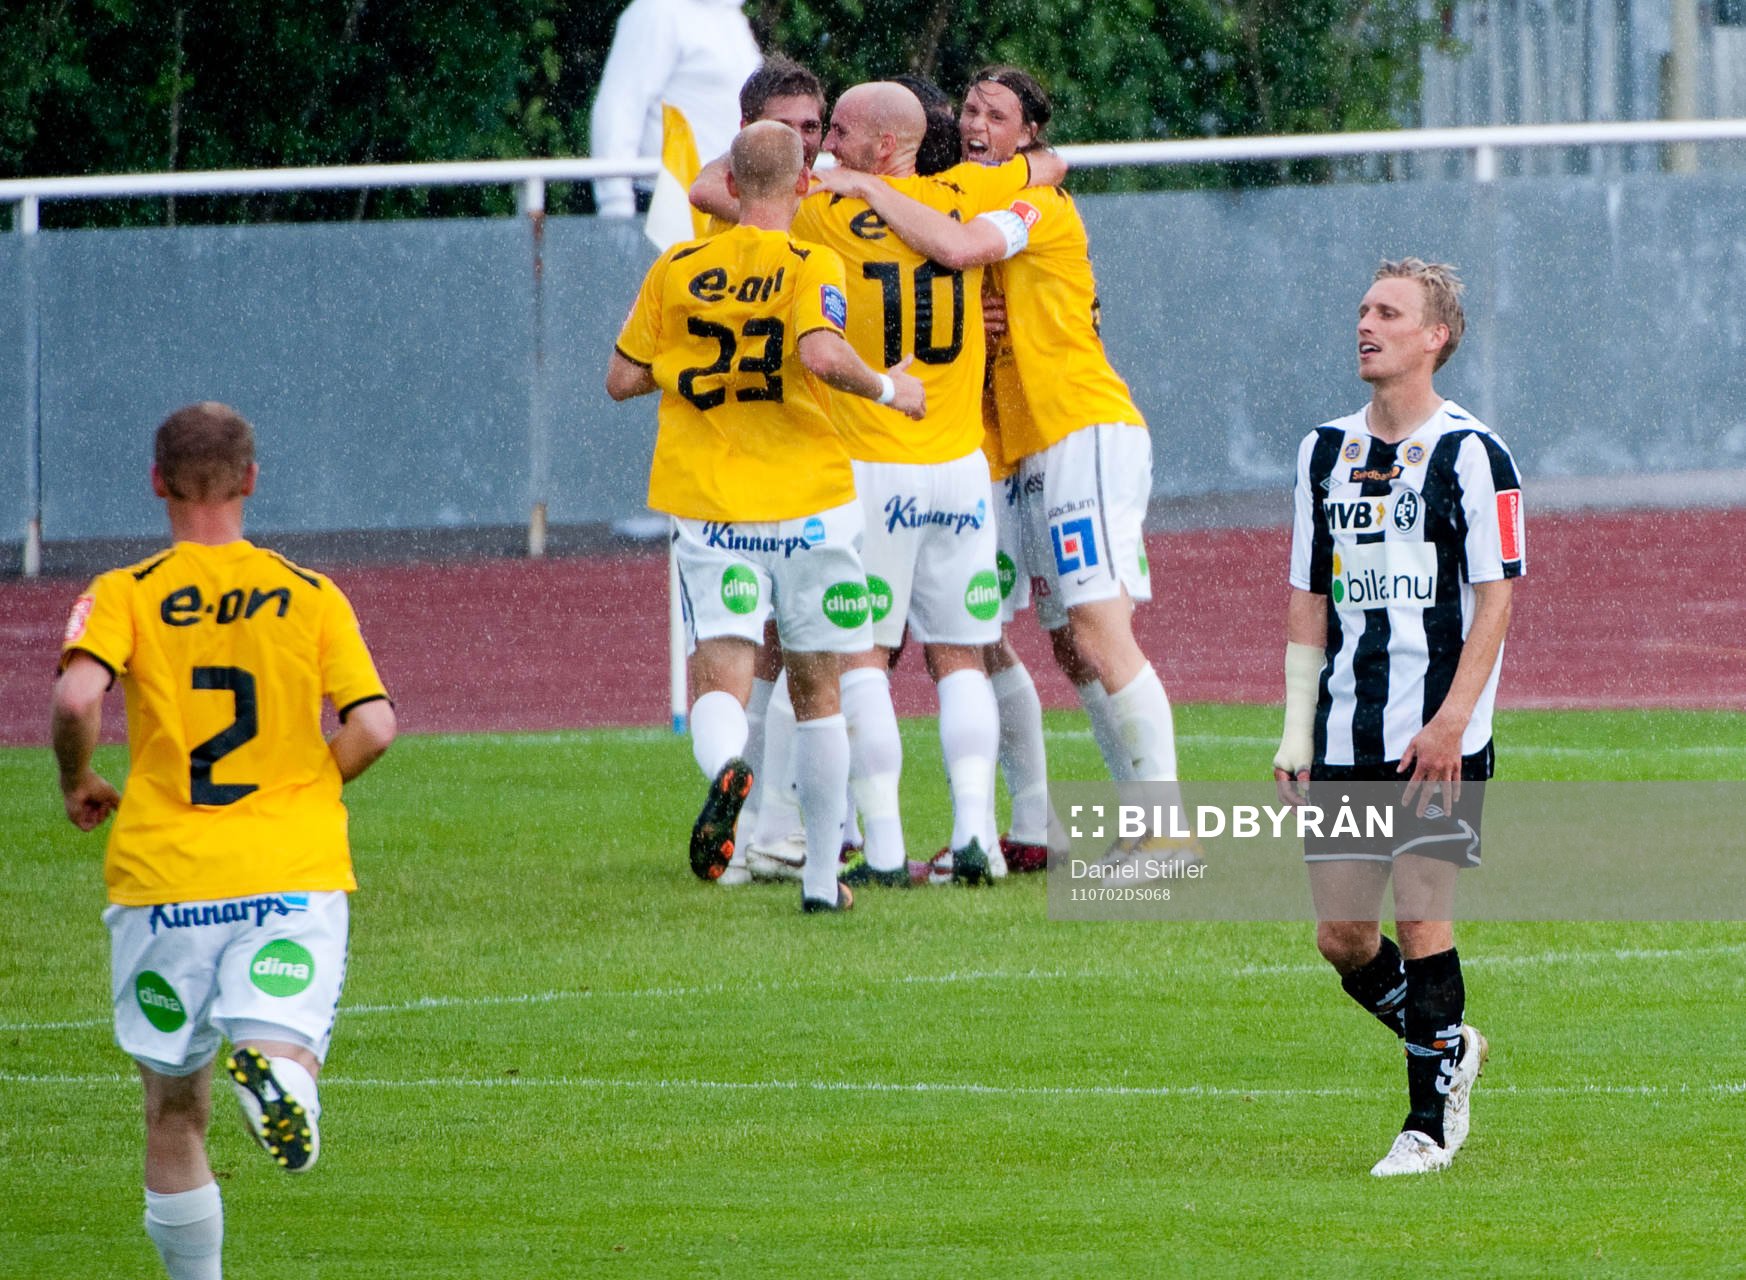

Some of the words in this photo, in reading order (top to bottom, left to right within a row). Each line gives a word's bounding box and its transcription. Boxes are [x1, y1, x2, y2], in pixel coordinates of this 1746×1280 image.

[863, 259, 964, 368] 10
[678, 316, 784, 411] 23
[724, 579, 757, 597] dina
[826, 595, 868, 612] dina
[190, 666, 259, 806] 2
[252, 957, 310, 980] dina
[138, 988, 182, 1012] dina
